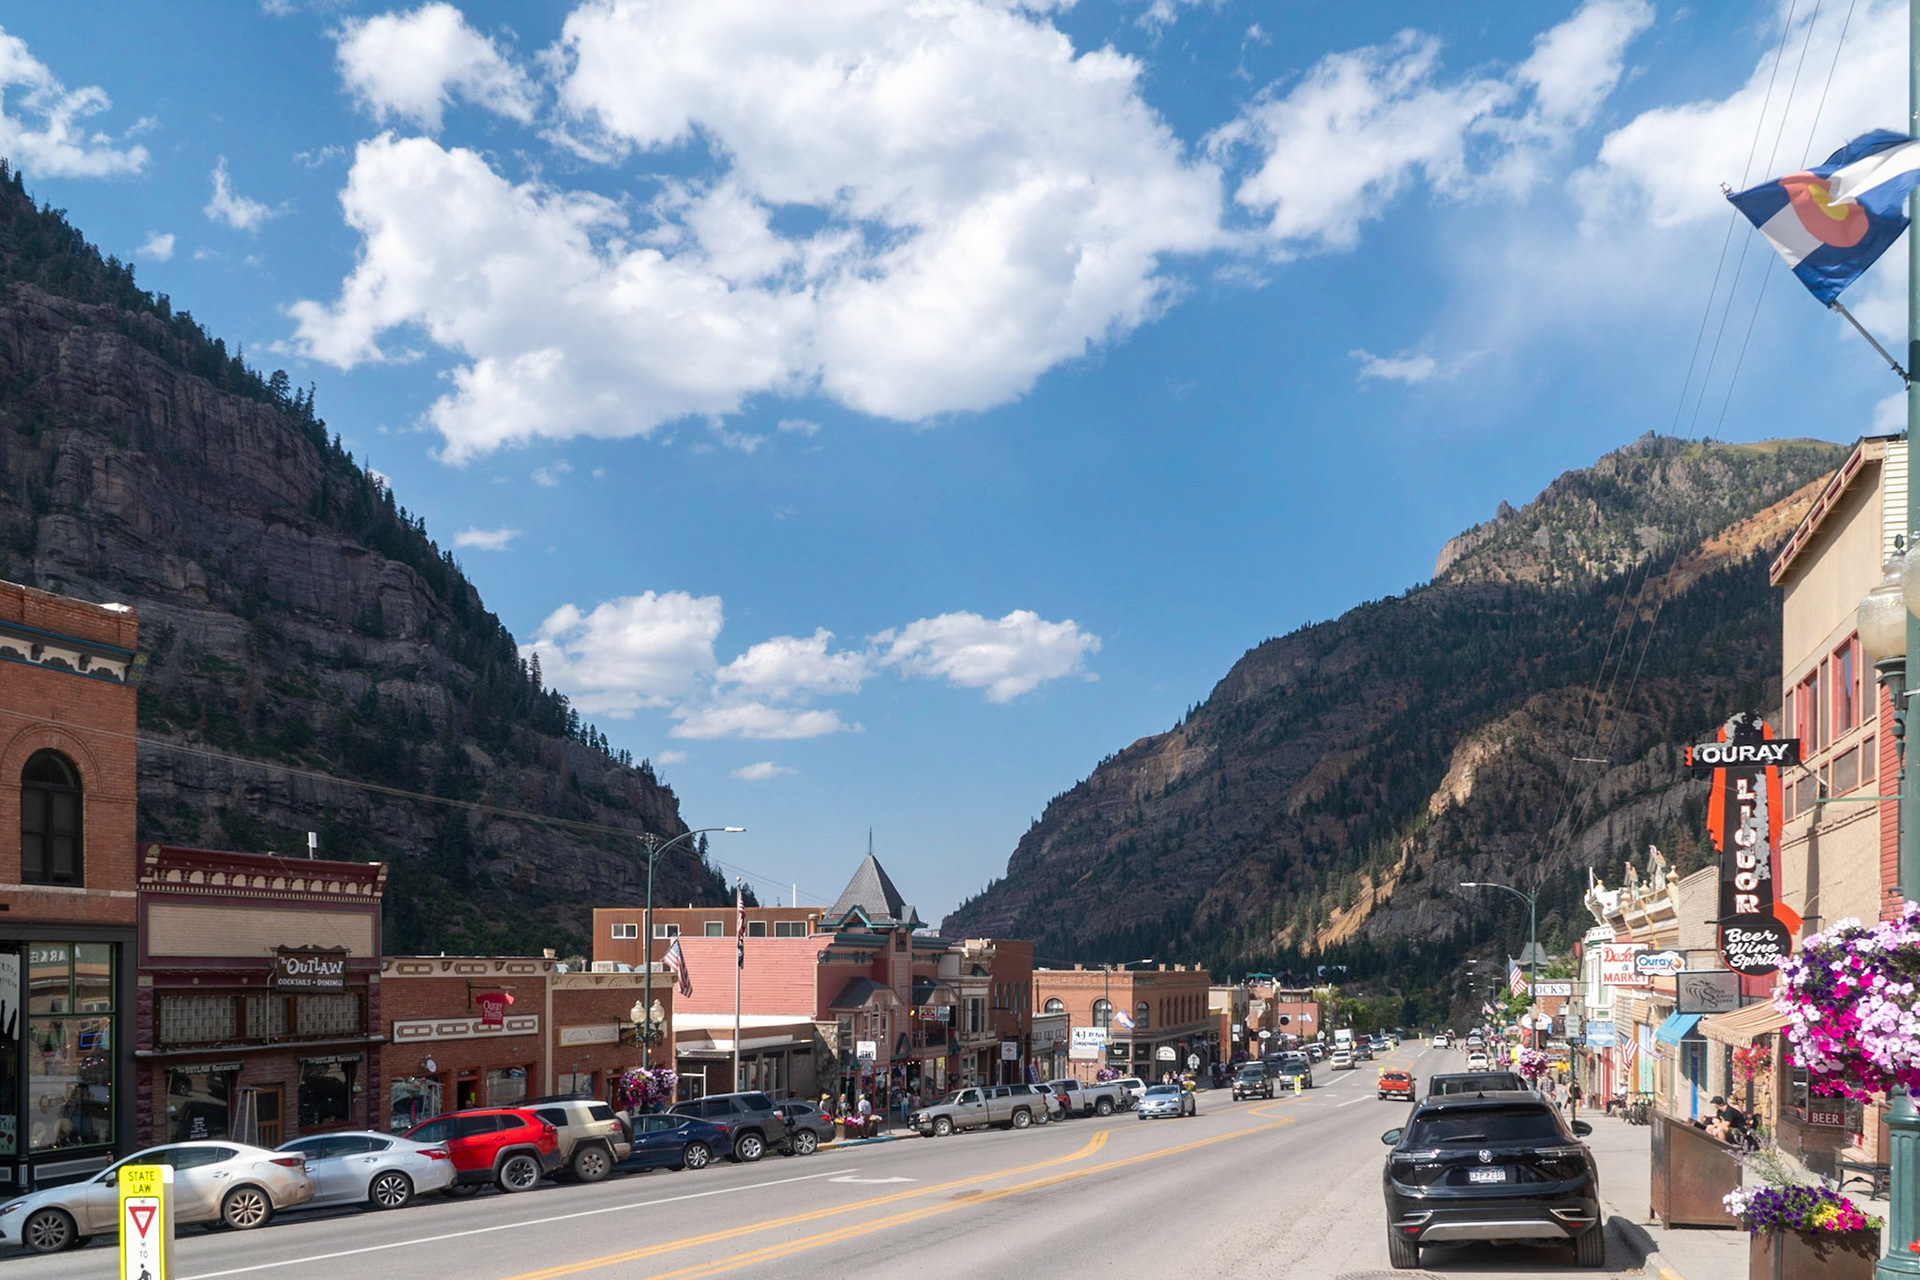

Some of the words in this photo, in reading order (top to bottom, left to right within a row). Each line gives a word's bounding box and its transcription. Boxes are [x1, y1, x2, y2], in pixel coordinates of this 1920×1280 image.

[1702, 744, 1789, 763] OURAY
[1725, 928, 1778, 942] Beer
[1726, 941, 1779, 954] Wine
[1639, 956, 1673, 967] Ouray
[1730, 953, 1776, 970] Spirit
[278, 978, 311, 986] COCKTAILS
[317, 979, 343, 987] DINING
[1603, 973, 1646, 982] MARKET
[1531, 984, 1565, 994] OCKS
[1812, 1112, 1839, 1124] BEER
[128, 1171, 155, 1182] STATE
[133, 1184, 151, 1194] LAW
[140, 1251, 148, 1259] TO
